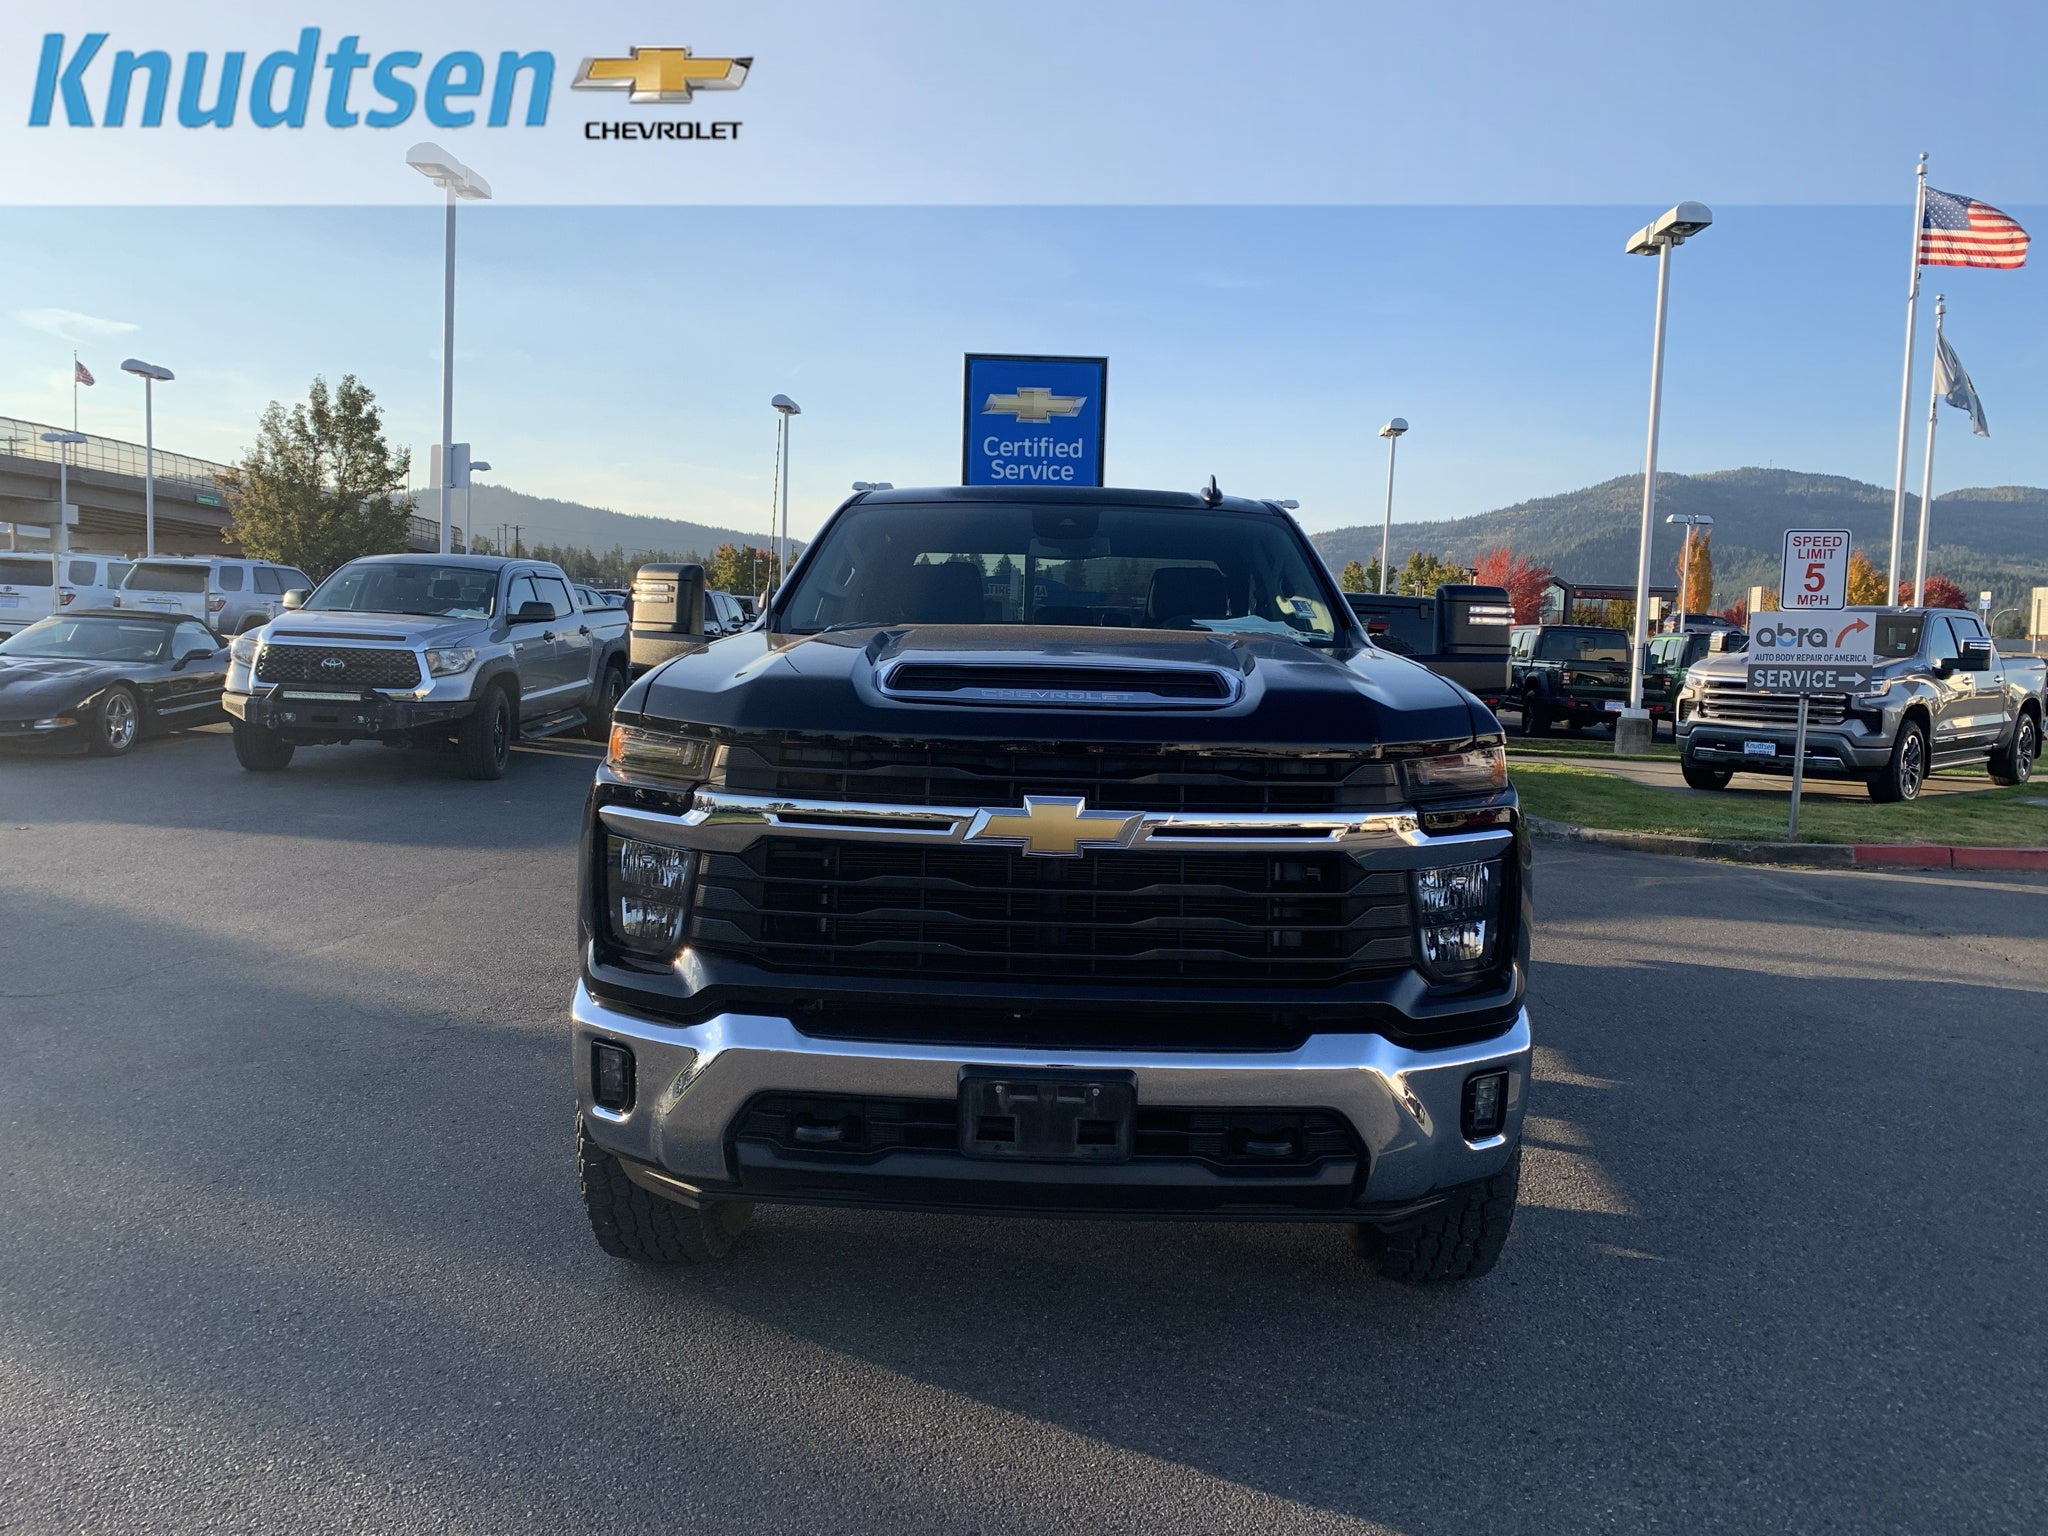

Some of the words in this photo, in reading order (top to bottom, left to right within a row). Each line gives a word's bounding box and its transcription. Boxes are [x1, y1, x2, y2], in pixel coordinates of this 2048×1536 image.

[983, 436, 1083, 458] Certified
[991, 459, 1074, 481] Service
[1792, 535, 1842, 547] SPEED
[1797, 548, 1836, 559] LIMIT
[1803, 562, 1825, 592] 5
[1797, 594, 1829, 605] MPH
[1756, 622, 1828, 648] abra
[1755, 653, 1775, 662] AUTO
[1775, 653, 1796, 662] BODY
[1796, 654, 1822, 662] REPAIR
[1823, 654, 1834, 662] OF
[1834, 654, 1867, 663] AMERICA
[1753, 669, 1837, 688] SERVICE
[981, 689, 1134, 701] CHEVROLET
